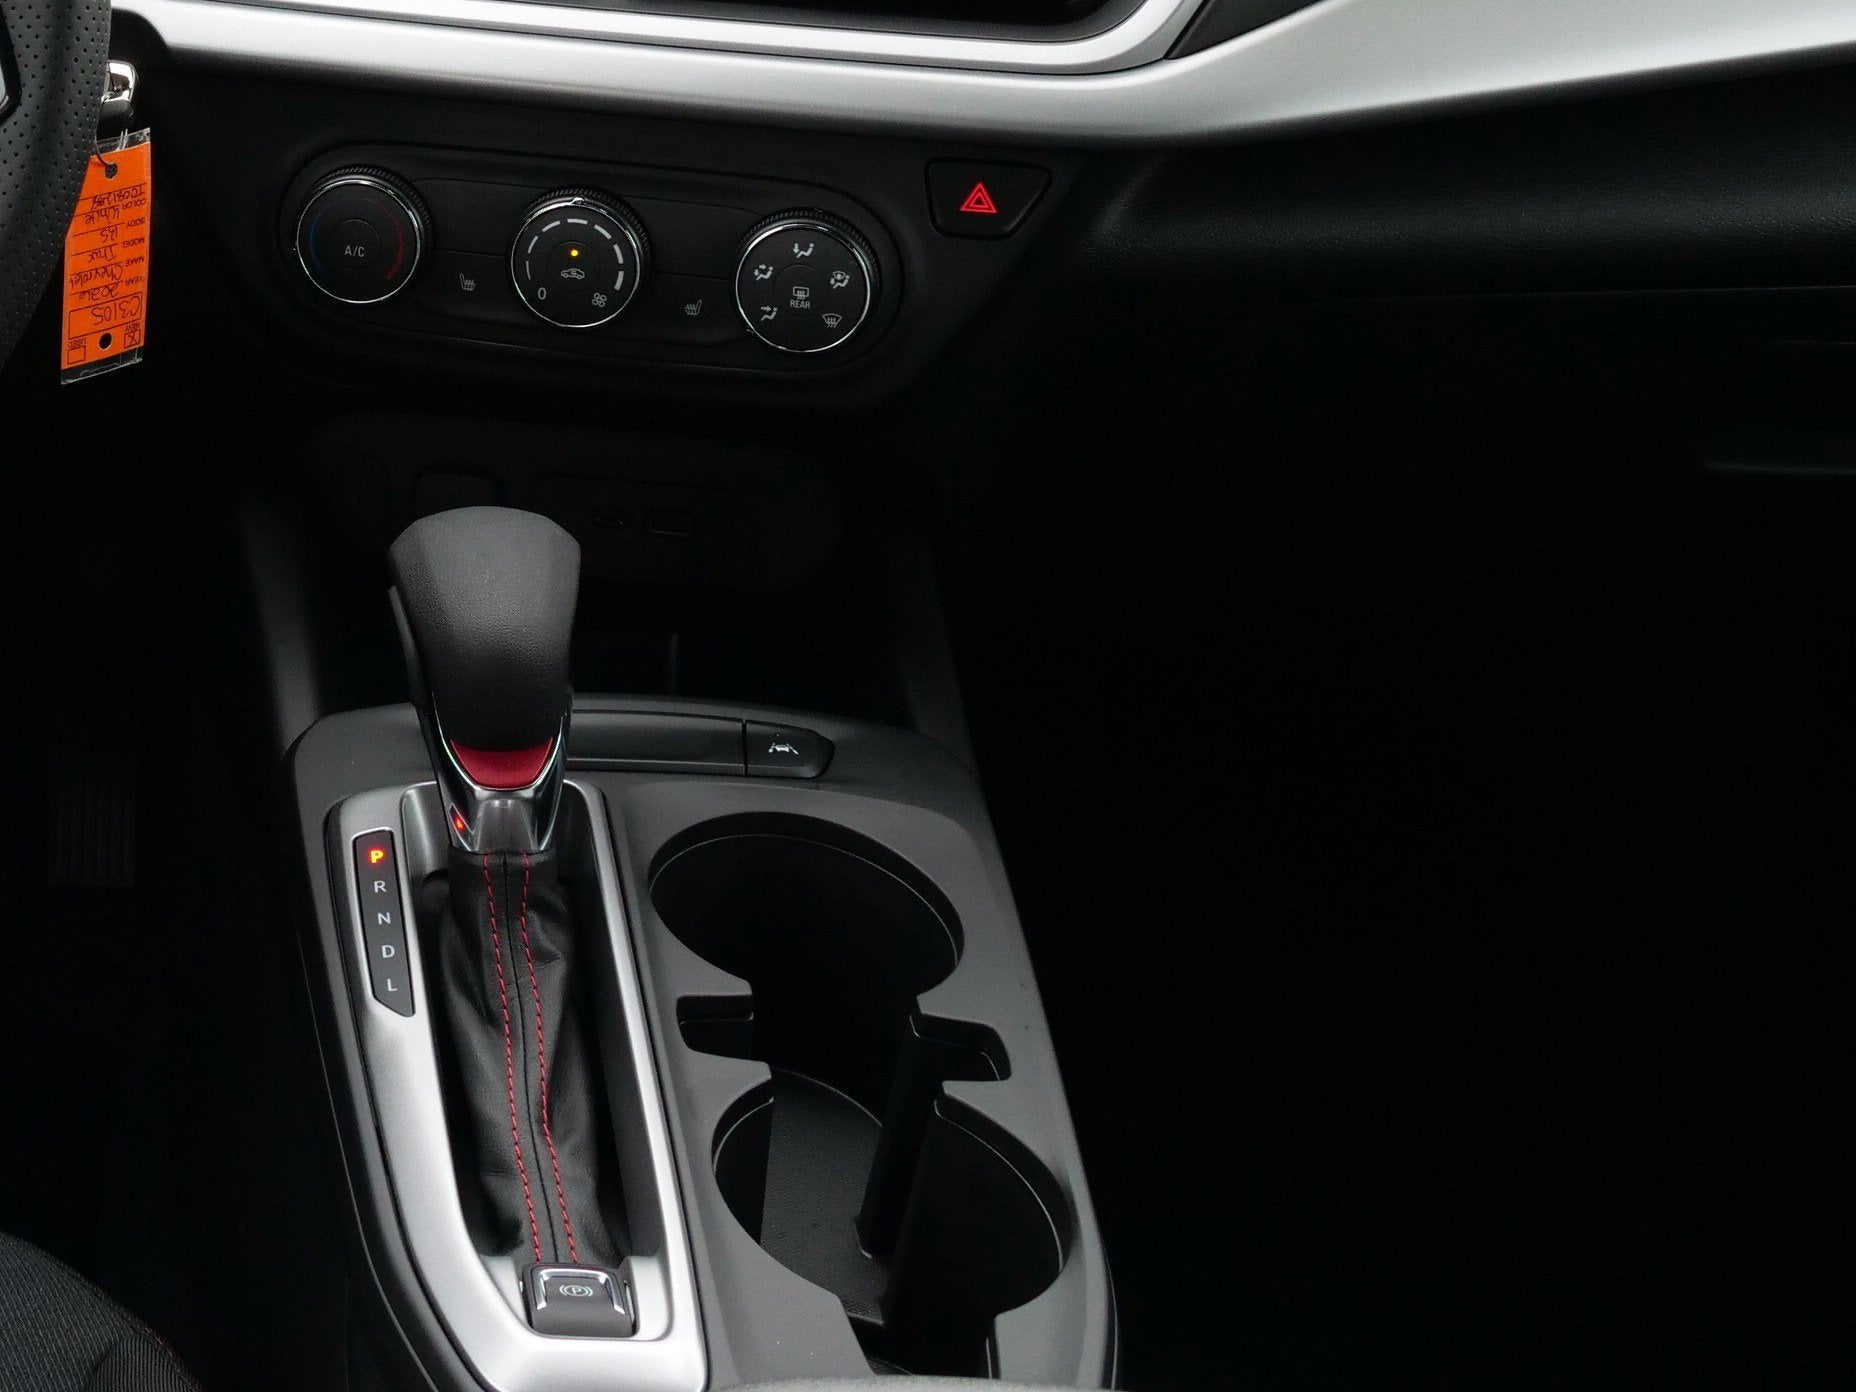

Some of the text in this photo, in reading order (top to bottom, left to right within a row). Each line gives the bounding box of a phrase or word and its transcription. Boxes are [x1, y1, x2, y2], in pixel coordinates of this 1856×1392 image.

[344, 245, 365, 258] A/C
[789, 299, 811, 309] REAR
[370, 850, 384, 864] P
[373, 880, 387, 893] R
[377, 912, 391, 925] N
[381, 945, 395, 958] D
[387, 978, 398, 992] L
